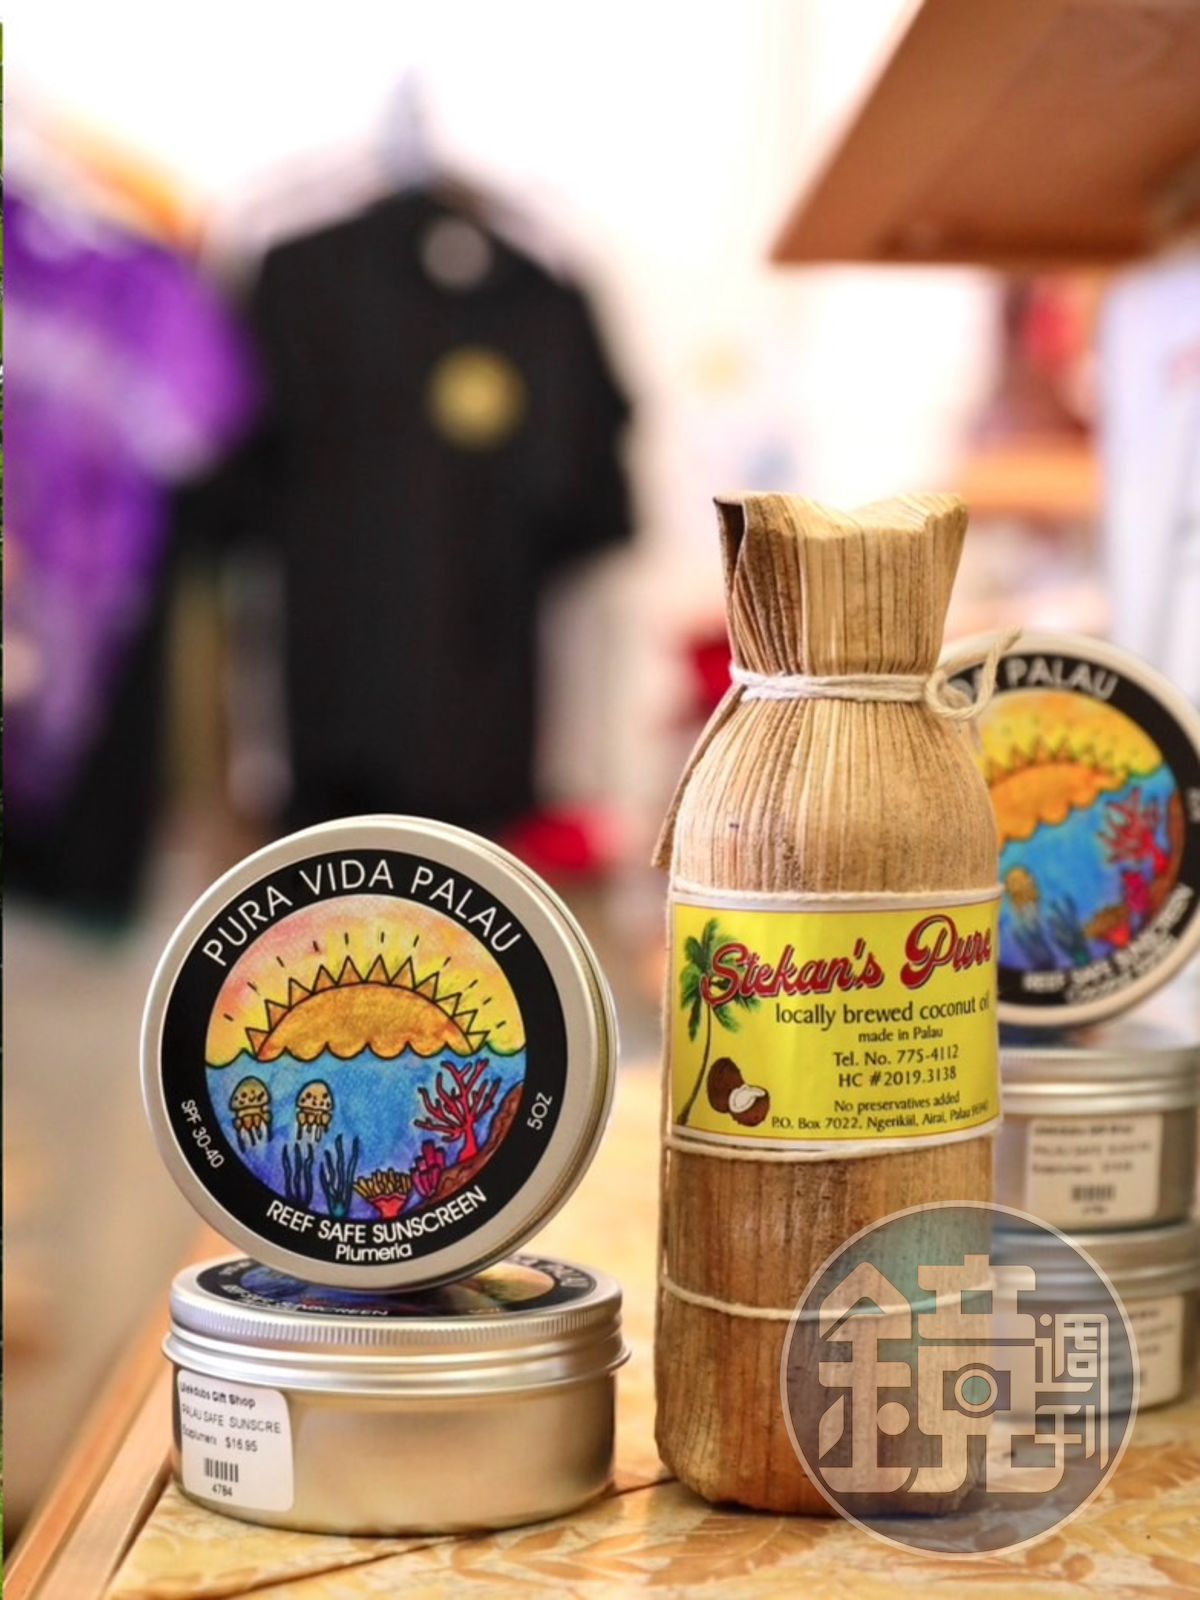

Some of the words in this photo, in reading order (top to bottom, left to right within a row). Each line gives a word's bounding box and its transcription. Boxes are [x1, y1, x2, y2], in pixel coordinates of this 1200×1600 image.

[1004, 655, 1119, 701] PALAU
[202, 885, 293, 967] PURA
[299, 858, 394, 896] VIDA
[410, 866, 522, 953] PALAU
[701, 937, 884, 1009] Stekan's
[776, 1003, 836, 1032] locally
[843, 1001, 913, 1024] brewed
[920, 998, 977, 1020] coconut
[858, 1028, 894, 1043] made
[898, 1028, 909, 1041] in
[913, 1026, 943, 1040] Palau
[833, 1051, 859, 1067] Tel.
[864, 1051, 892, 1066] No.
[896, 1045, 960, 1063] 775-4112
[838, 1072, 863, 1088] HC
[870, 1066, 957, 1087] #2019.3138
[526, 1091, 553, 1130] 5OZ
[834, 1100, 853, 1113] No
[857, 1098, 930, 1115] preservatives
[933, 1091, 960, 1105] added
[181, 1099, 202, 1124] SPF
[192, 1126, 225, 1168] 30-40
[798, 1117, 820, 1129] Box
[266, 1200, 315, 1233] REEF
[317, 1219, 367, 1244] SAFE
[372, 1185, 487, 1244] SUNSCREEN
[335, 1243, 413, 1261] Plumeria
[228, 1394, 256, 1410] Shop
[203, 1410, 224, 1427] SAFE
[229, 1416, 282, 1434] SUNSCRE
